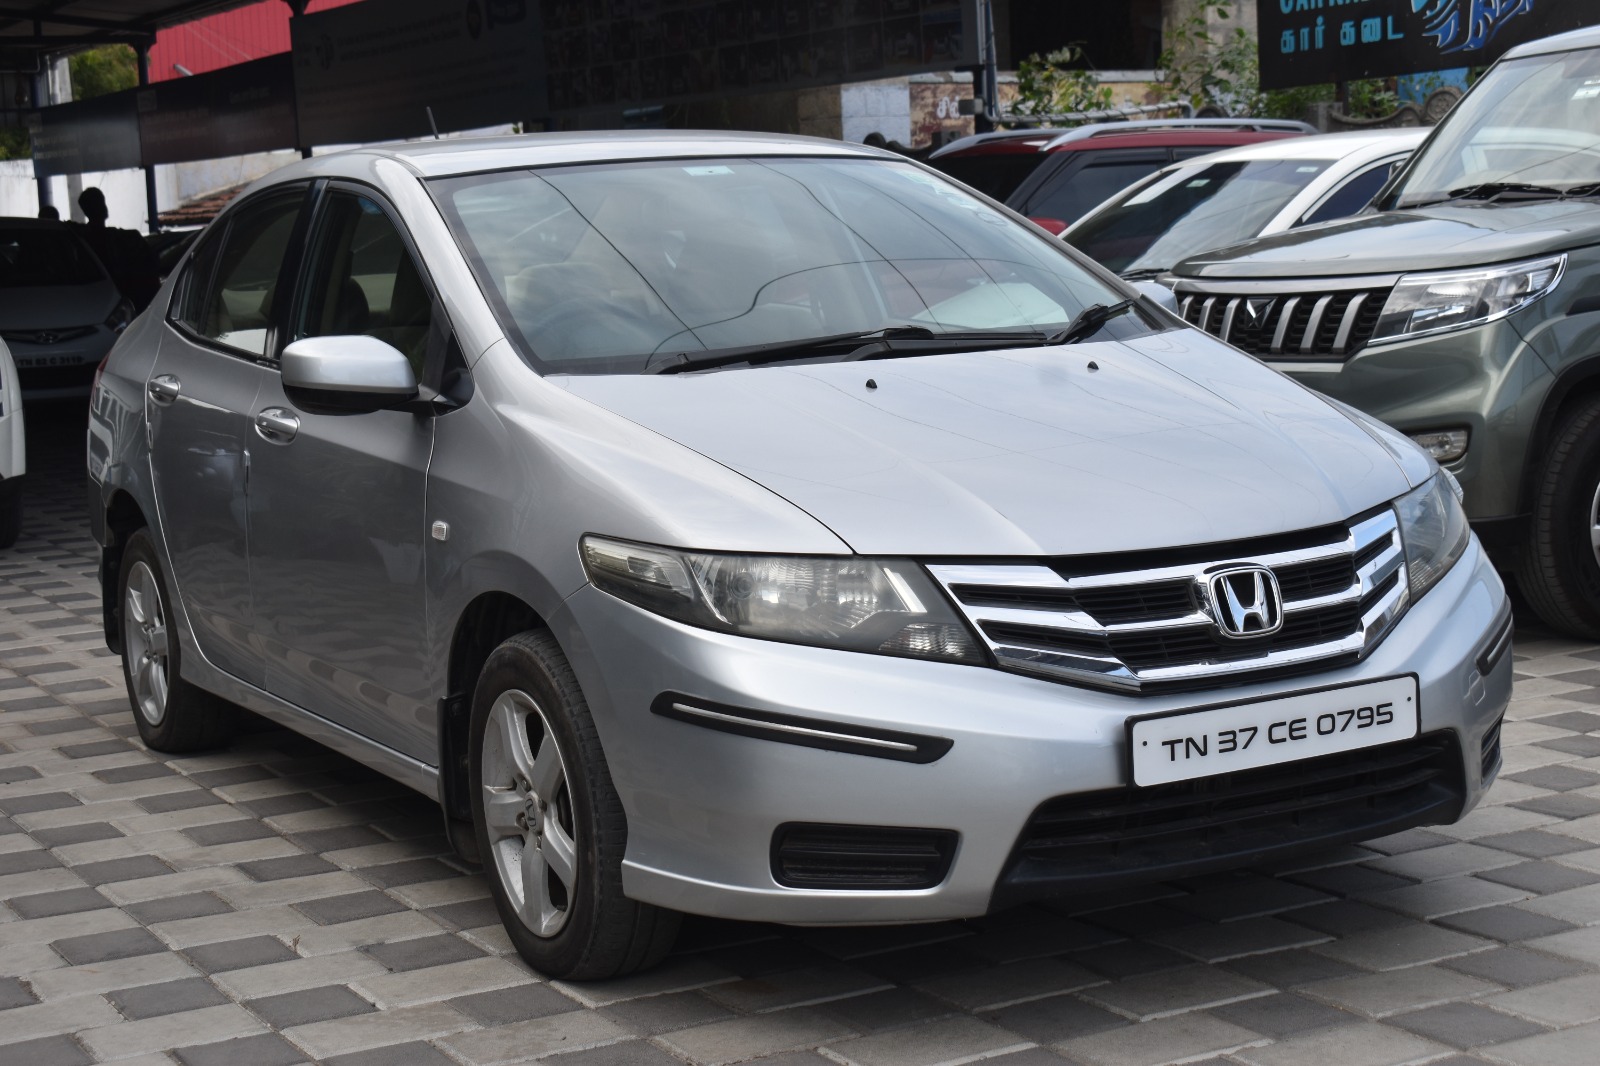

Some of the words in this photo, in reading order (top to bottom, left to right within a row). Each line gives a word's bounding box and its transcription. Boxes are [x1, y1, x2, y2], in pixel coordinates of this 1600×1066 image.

[1280, 15, 1325, 54] கார்
[1340, 15, 1404, 46] கடை
[1161, 734, 1208, 761] TN
[1218, 726, 1259, 754] 37
[1267, 717, 1307, 745] CE
[1316, 702, 1393, 736] 0795
